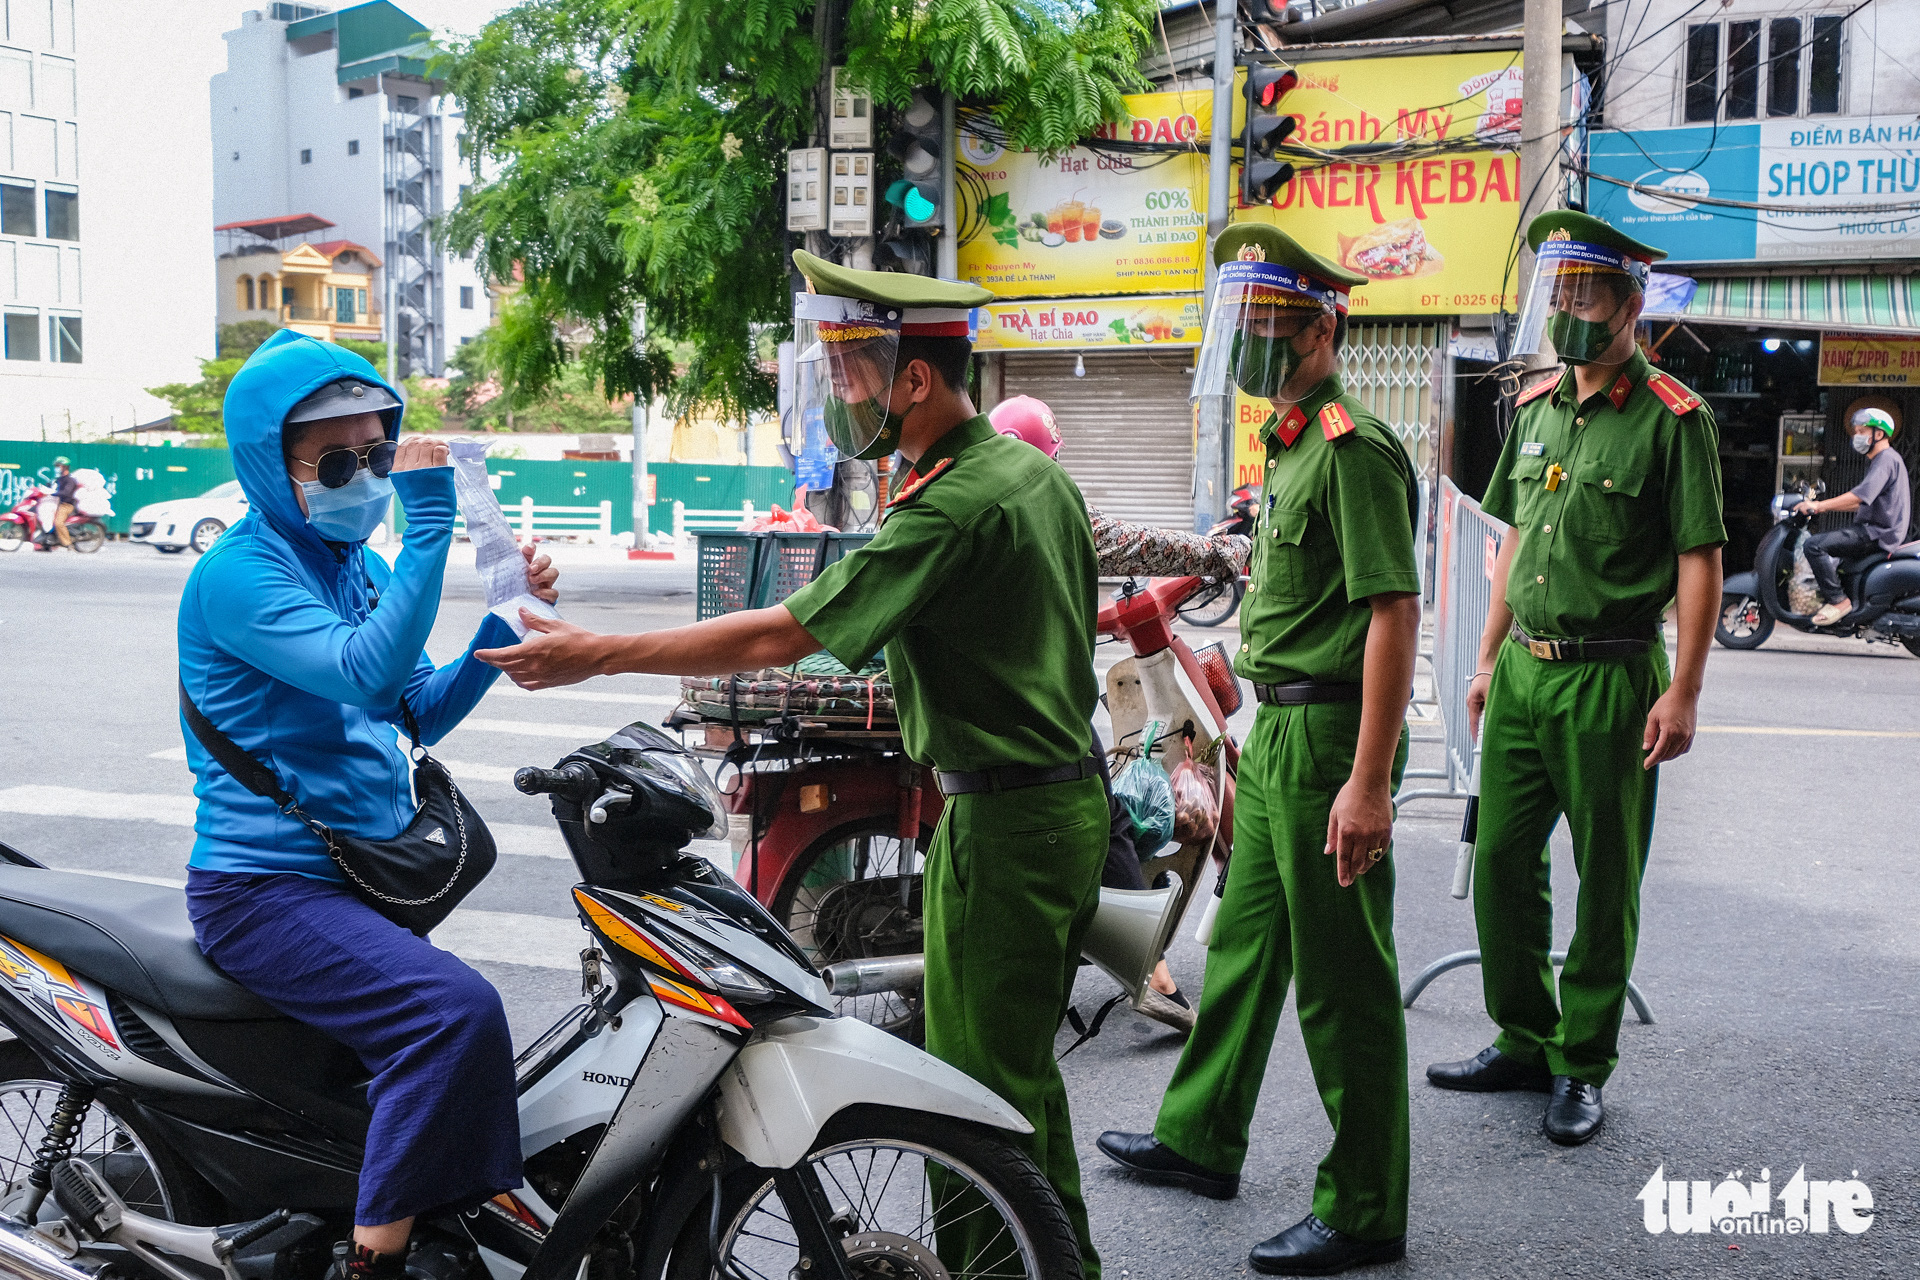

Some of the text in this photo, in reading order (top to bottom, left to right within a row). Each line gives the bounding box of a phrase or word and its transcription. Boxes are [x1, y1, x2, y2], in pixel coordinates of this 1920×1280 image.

[1131, 115, 1198, 143] ĐAO
[1283, 110, 1382, 144] Bánh
[1790, 124, 1842, 146] ĐIỂM
[1060, 153, 1133, 175] Hạt Chia
[1768, 160, 1850, 197] SHOP
[1395, 158, 1520, 220] KEBA
[1145, 190, 1189, 210] 60%
[1130, 213, 1171, 228] THÀNH
[1138, 231, 1197, 244] LÀ BÍ ĐAO
[985, 263, 1021, 273] Nguyen
[1023, 262, 1037, 272] My
[986, 275, 1003, 283] 393A
[1421, 295, 1440, 306] ĐT
[1454, 294, 1487, 306] 0325
[998, 308, 1099, 332] TRÀ BÍ ĐAO
[1030, 327, 1073, 342] Hạt Chia
[1856, 350, 1889, 368] ZIPPO
